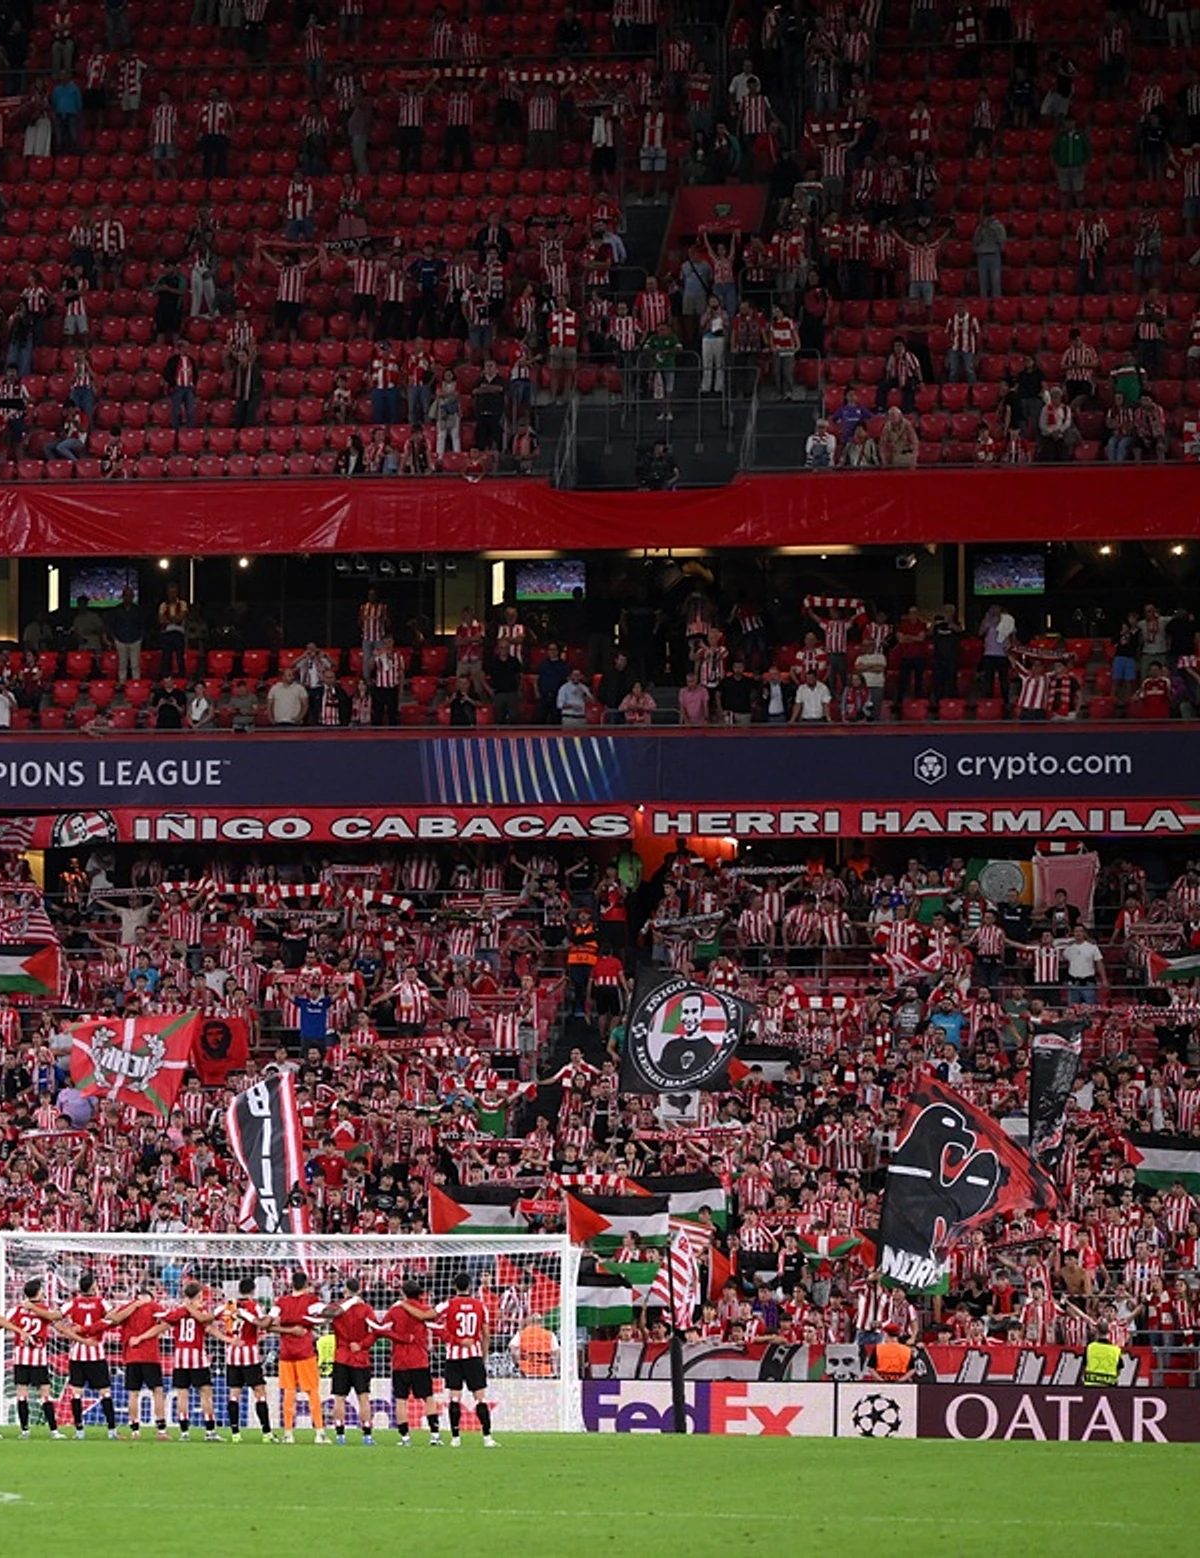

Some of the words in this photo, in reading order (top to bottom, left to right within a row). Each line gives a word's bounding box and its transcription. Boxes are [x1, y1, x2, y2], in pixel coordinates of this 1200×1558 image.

[957, 752, 1132, 779] crypto.com
[134, 812, 312, 840] IÑIGO
[331, 814, 630, 840] CABACAS
[654, 811, 840, 834] HERRI
[861, 809, 1184, 833] HARMAILA
[20, 1316, 41, 1337] 22
[179, 1317, 196, 1343] 18
[455, 1312, 477, 1337] 30
[582, 1380, 804, 1436] FedEx
